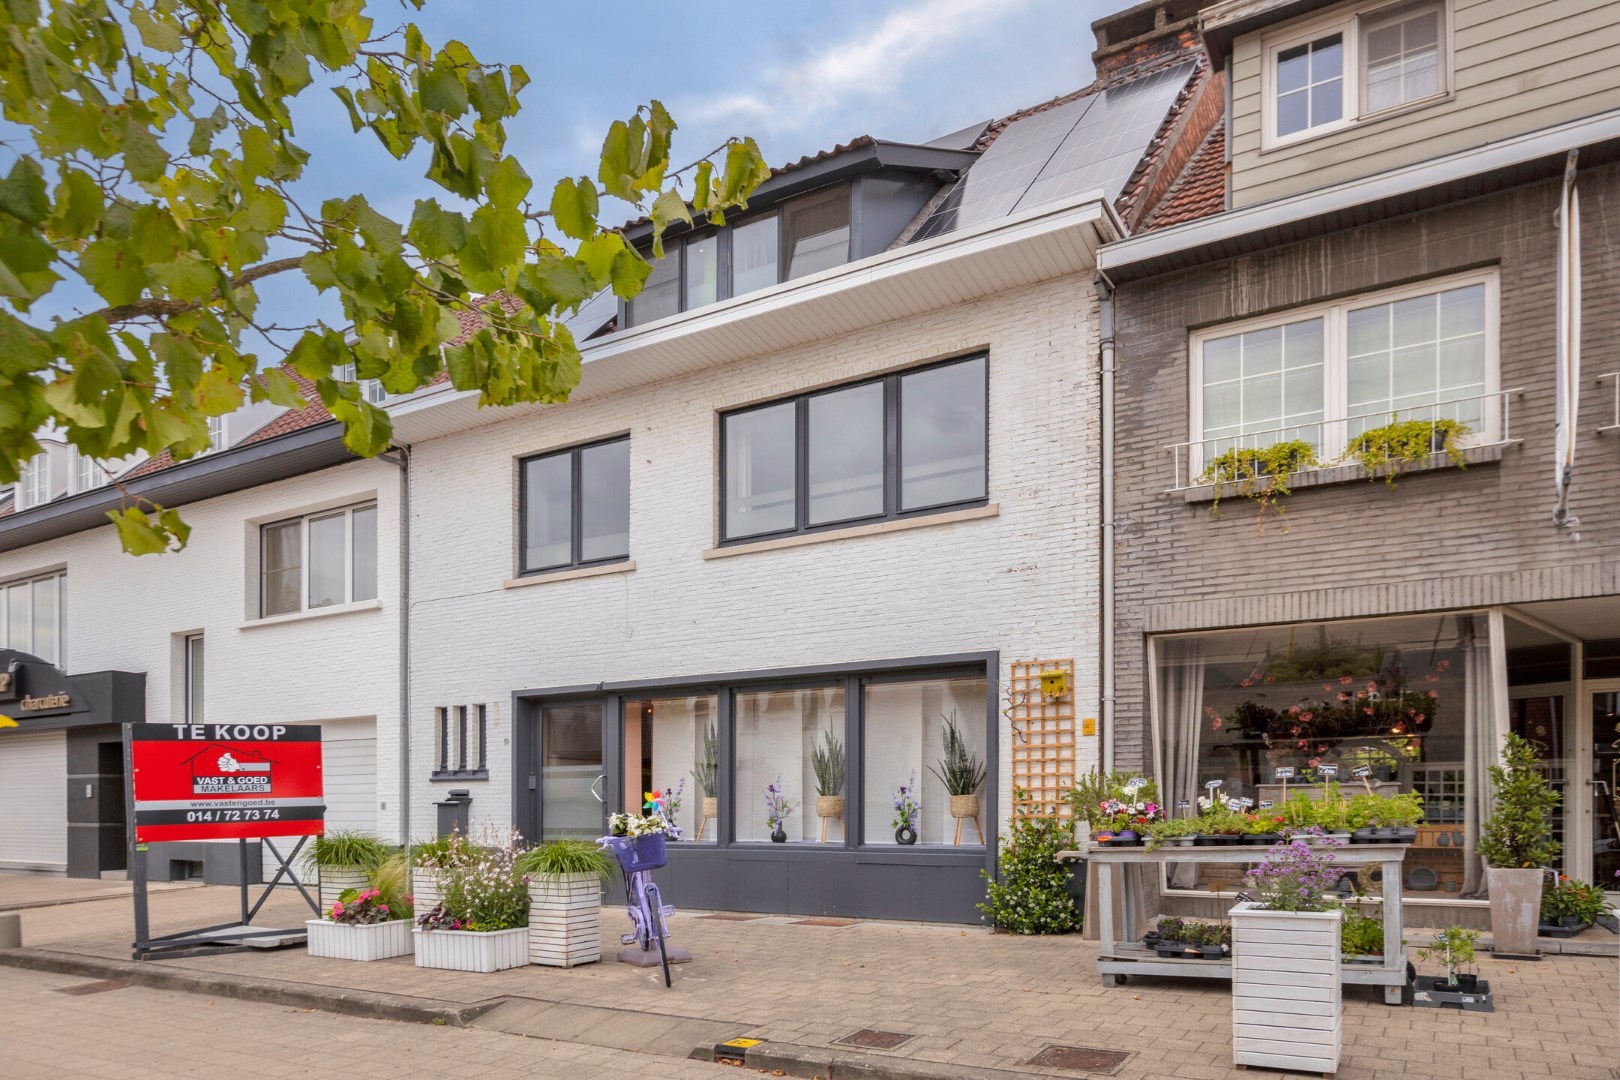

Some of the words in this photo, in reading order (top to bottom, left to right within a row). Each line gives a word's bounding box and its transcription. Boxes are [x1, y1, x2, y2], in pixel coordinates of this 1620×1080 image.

[173, 724, 206, 740] TE
[215, 725, 286, 740] KOOP
[237, 776, 268, 784] GOED
[201, 785, 265, 793] MAKELAARS
[190, 800, 275, 808] www.vastengoed.be
[186, 811, 212, 822] 014
[224, 810, 241, 821] 72
[244, 810, 260, 820] 73
[264, 809, 280, 820] 74
